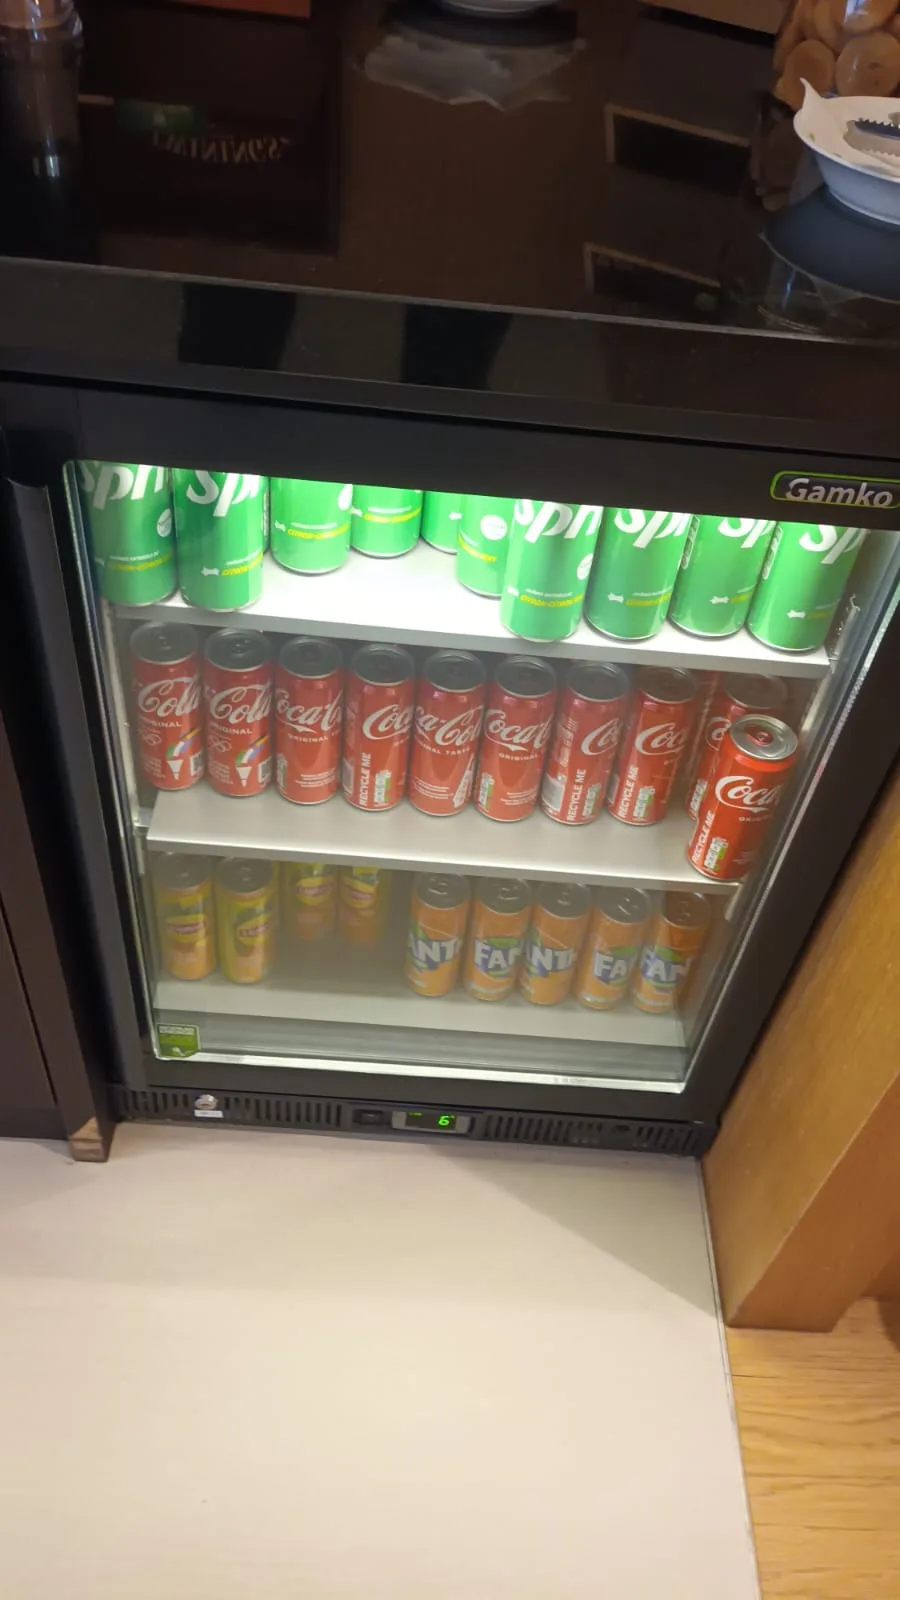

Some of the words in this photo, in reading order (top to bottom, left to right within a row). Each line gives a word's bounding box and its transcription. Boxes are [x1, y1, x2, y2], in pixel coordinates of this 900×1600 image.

[785, 478, 893, 507] Gamko
[359, 768, 370, 806] RECYCLE
[567, 784, 584, 821] RECYCLE
[577, 768, 587, 784] ME
[617, 780, 635, 818] RECYCLE
[628, 764, 639, 781] ME
